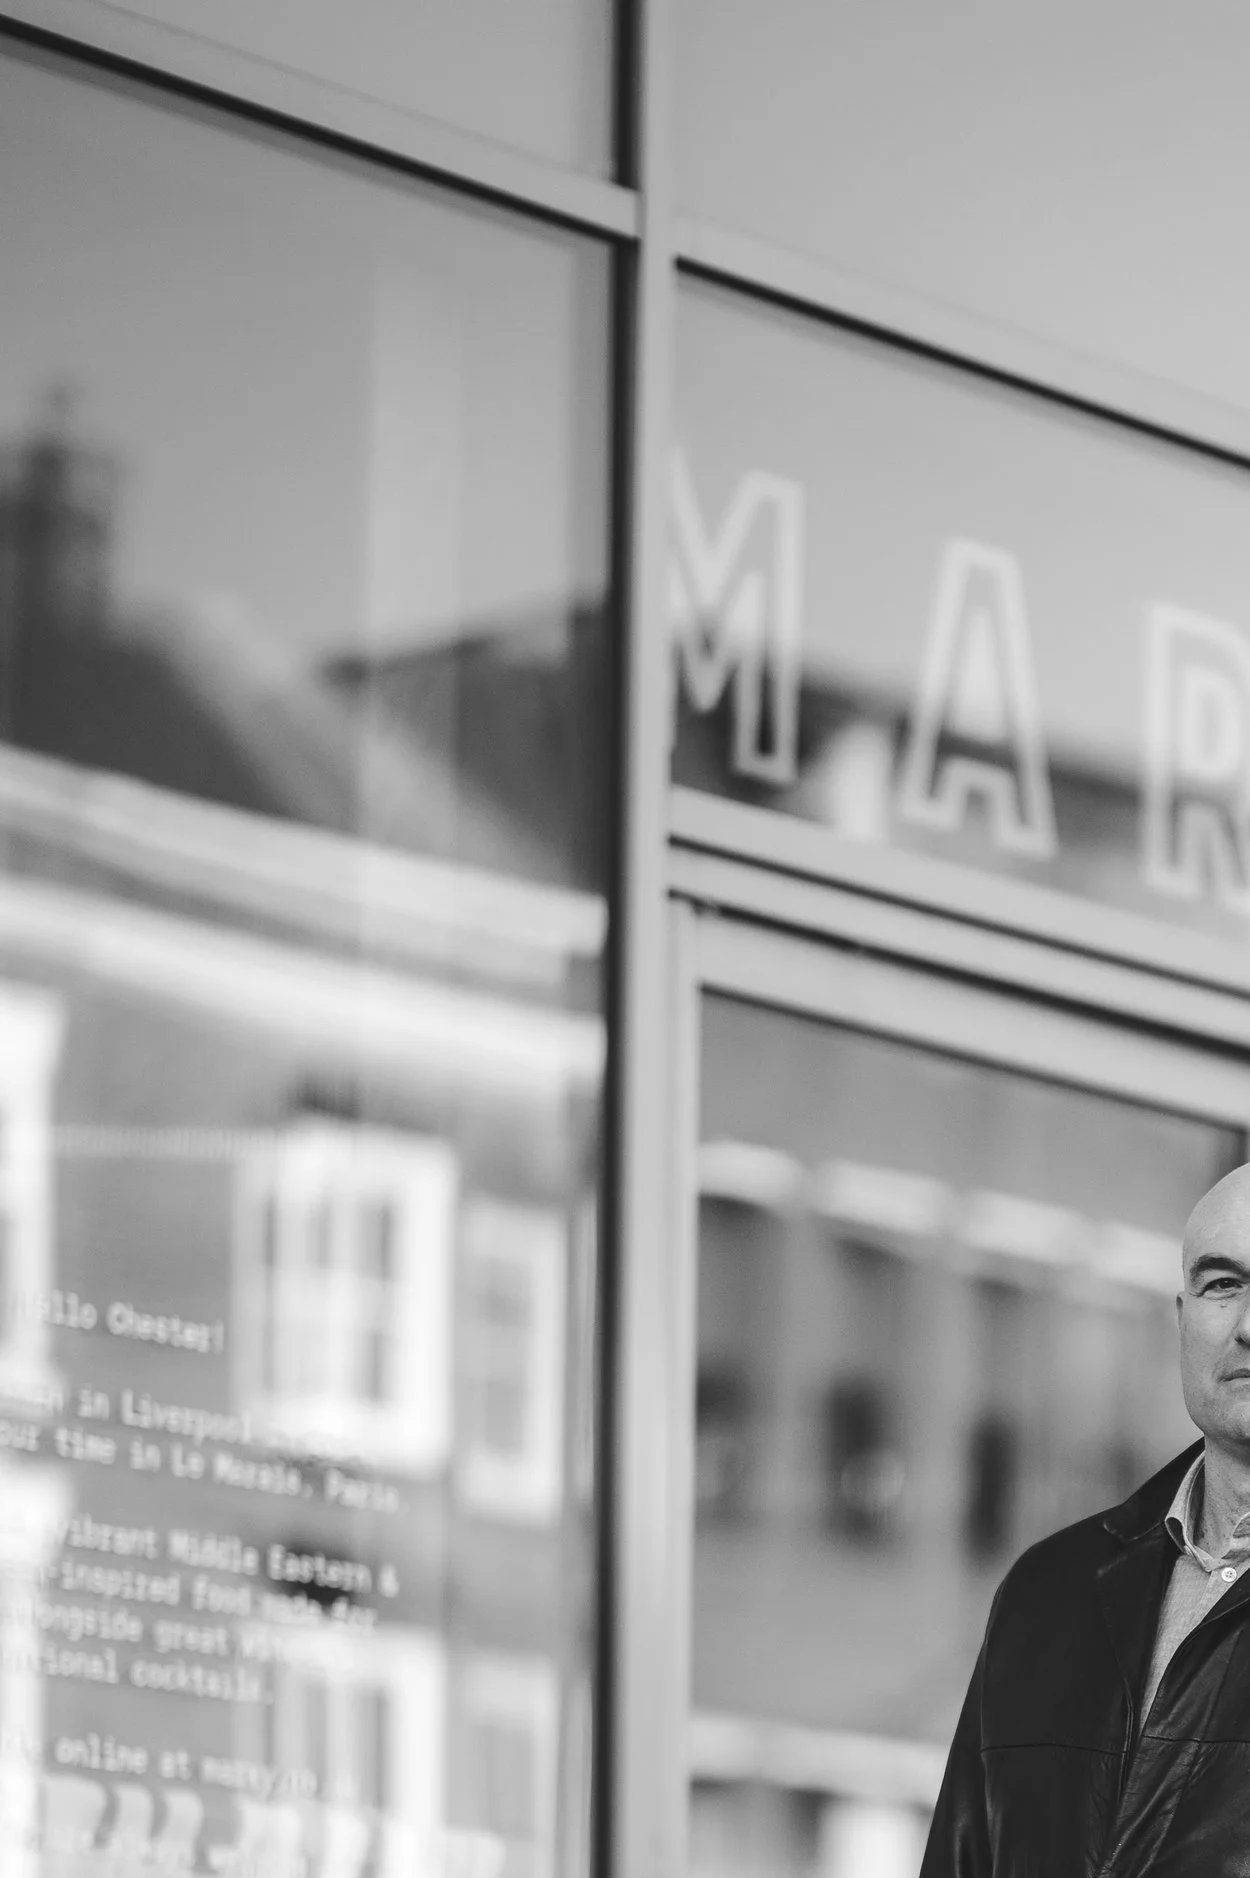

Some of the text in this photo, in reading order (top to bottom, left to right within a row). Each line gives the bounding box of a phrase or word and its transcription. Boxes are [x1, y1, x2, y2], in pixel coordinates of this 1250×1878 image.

[107, 1301, 225, 1356] Chester!
[78, 1384, 111, 1422] in
[120, 1388, 250, 1445] Liverpool
[55, 1426, 118, 1465] time
[130, 1435, 162, 1473] in
[168, 1526, 260, 1576] Middle
[267, 1543, 372, 1595] Eastern
[193, 1573, 251, 1616] food
[154, 1618, 228, 1656] great
[55, 1732, 149, 1775] online
[159, 1746, 192, 1780] at
